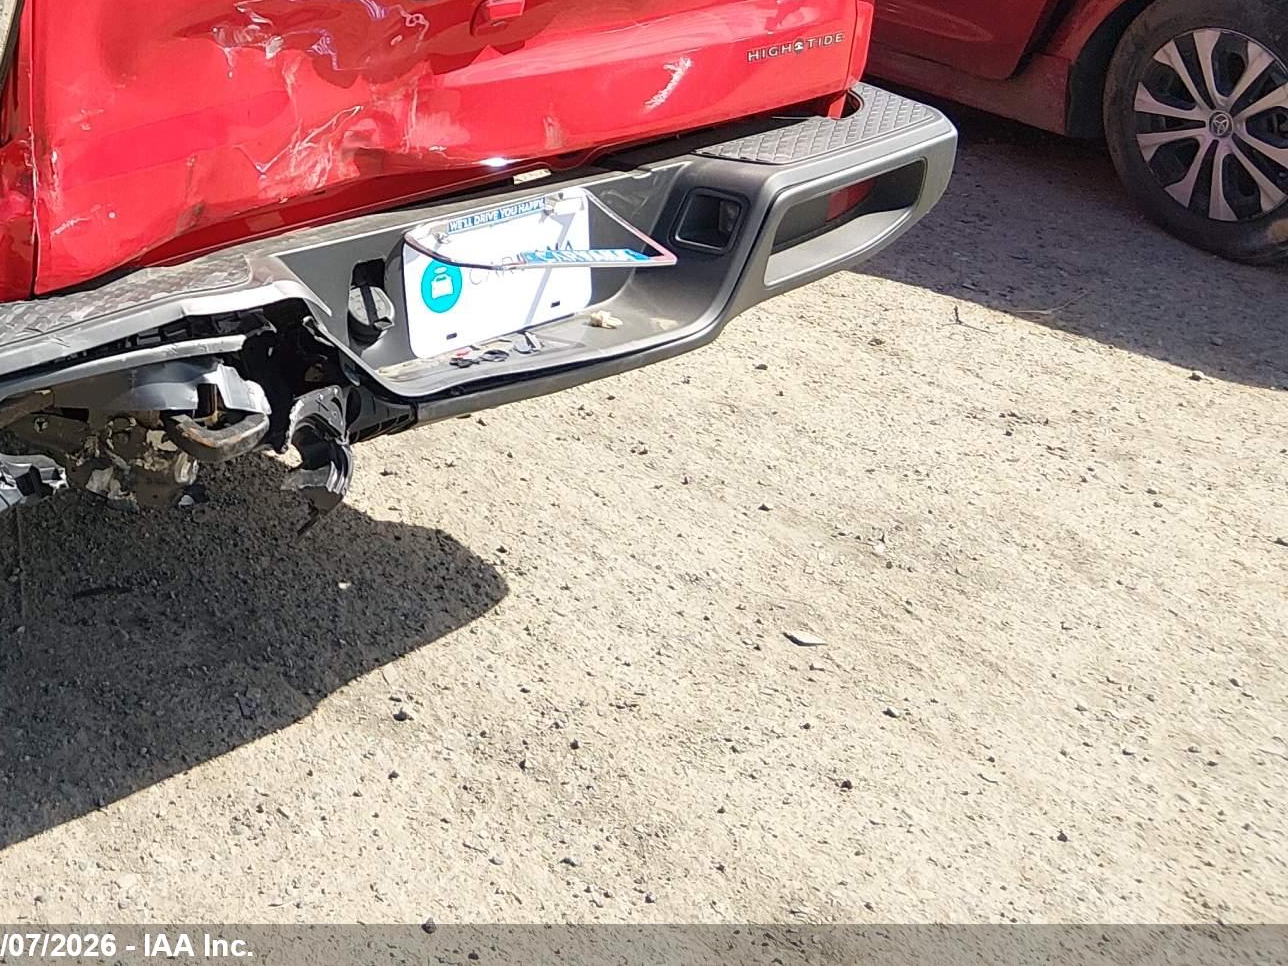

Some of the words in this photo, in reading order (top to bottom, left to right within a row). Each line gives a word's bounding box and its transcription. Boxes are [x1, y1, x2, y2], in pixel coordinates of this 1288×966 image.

[747, 43, 793, 63] HIGH
[806, 32, 844, 50] TIDE
[449, 216, 473, 233] WE'LL
[475, 210, 500, 228] DRIVE
[500, 205, 518, 223] YOU
[518, 198, 546, 217] HAPPY
